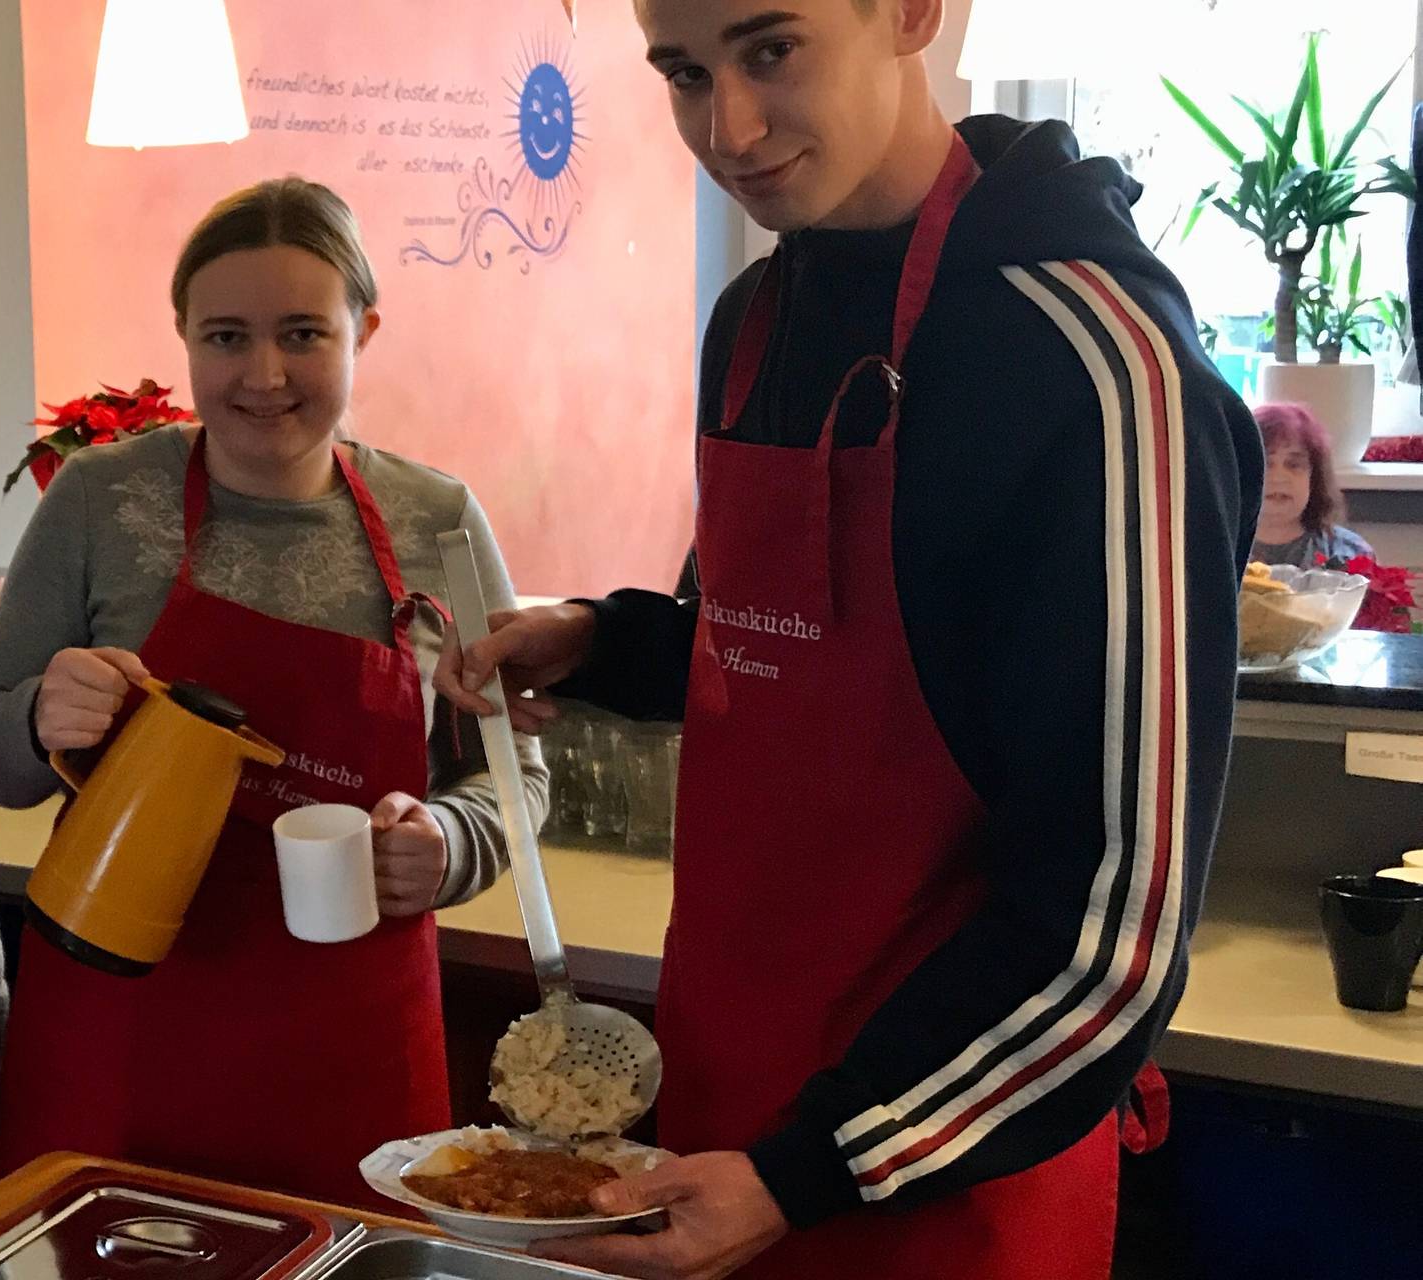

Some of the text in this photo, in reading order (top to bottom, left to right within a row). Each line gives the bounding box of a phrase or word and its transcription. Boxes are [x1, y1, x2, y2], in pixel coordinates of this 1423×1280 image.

[250, 110, 280, 130] und
[285, 112, 347, 135] dennoch
[378, 121, 395, 136] es
[399, 117, 422, 137] das
[723, 647, 779, 679] Hamm
